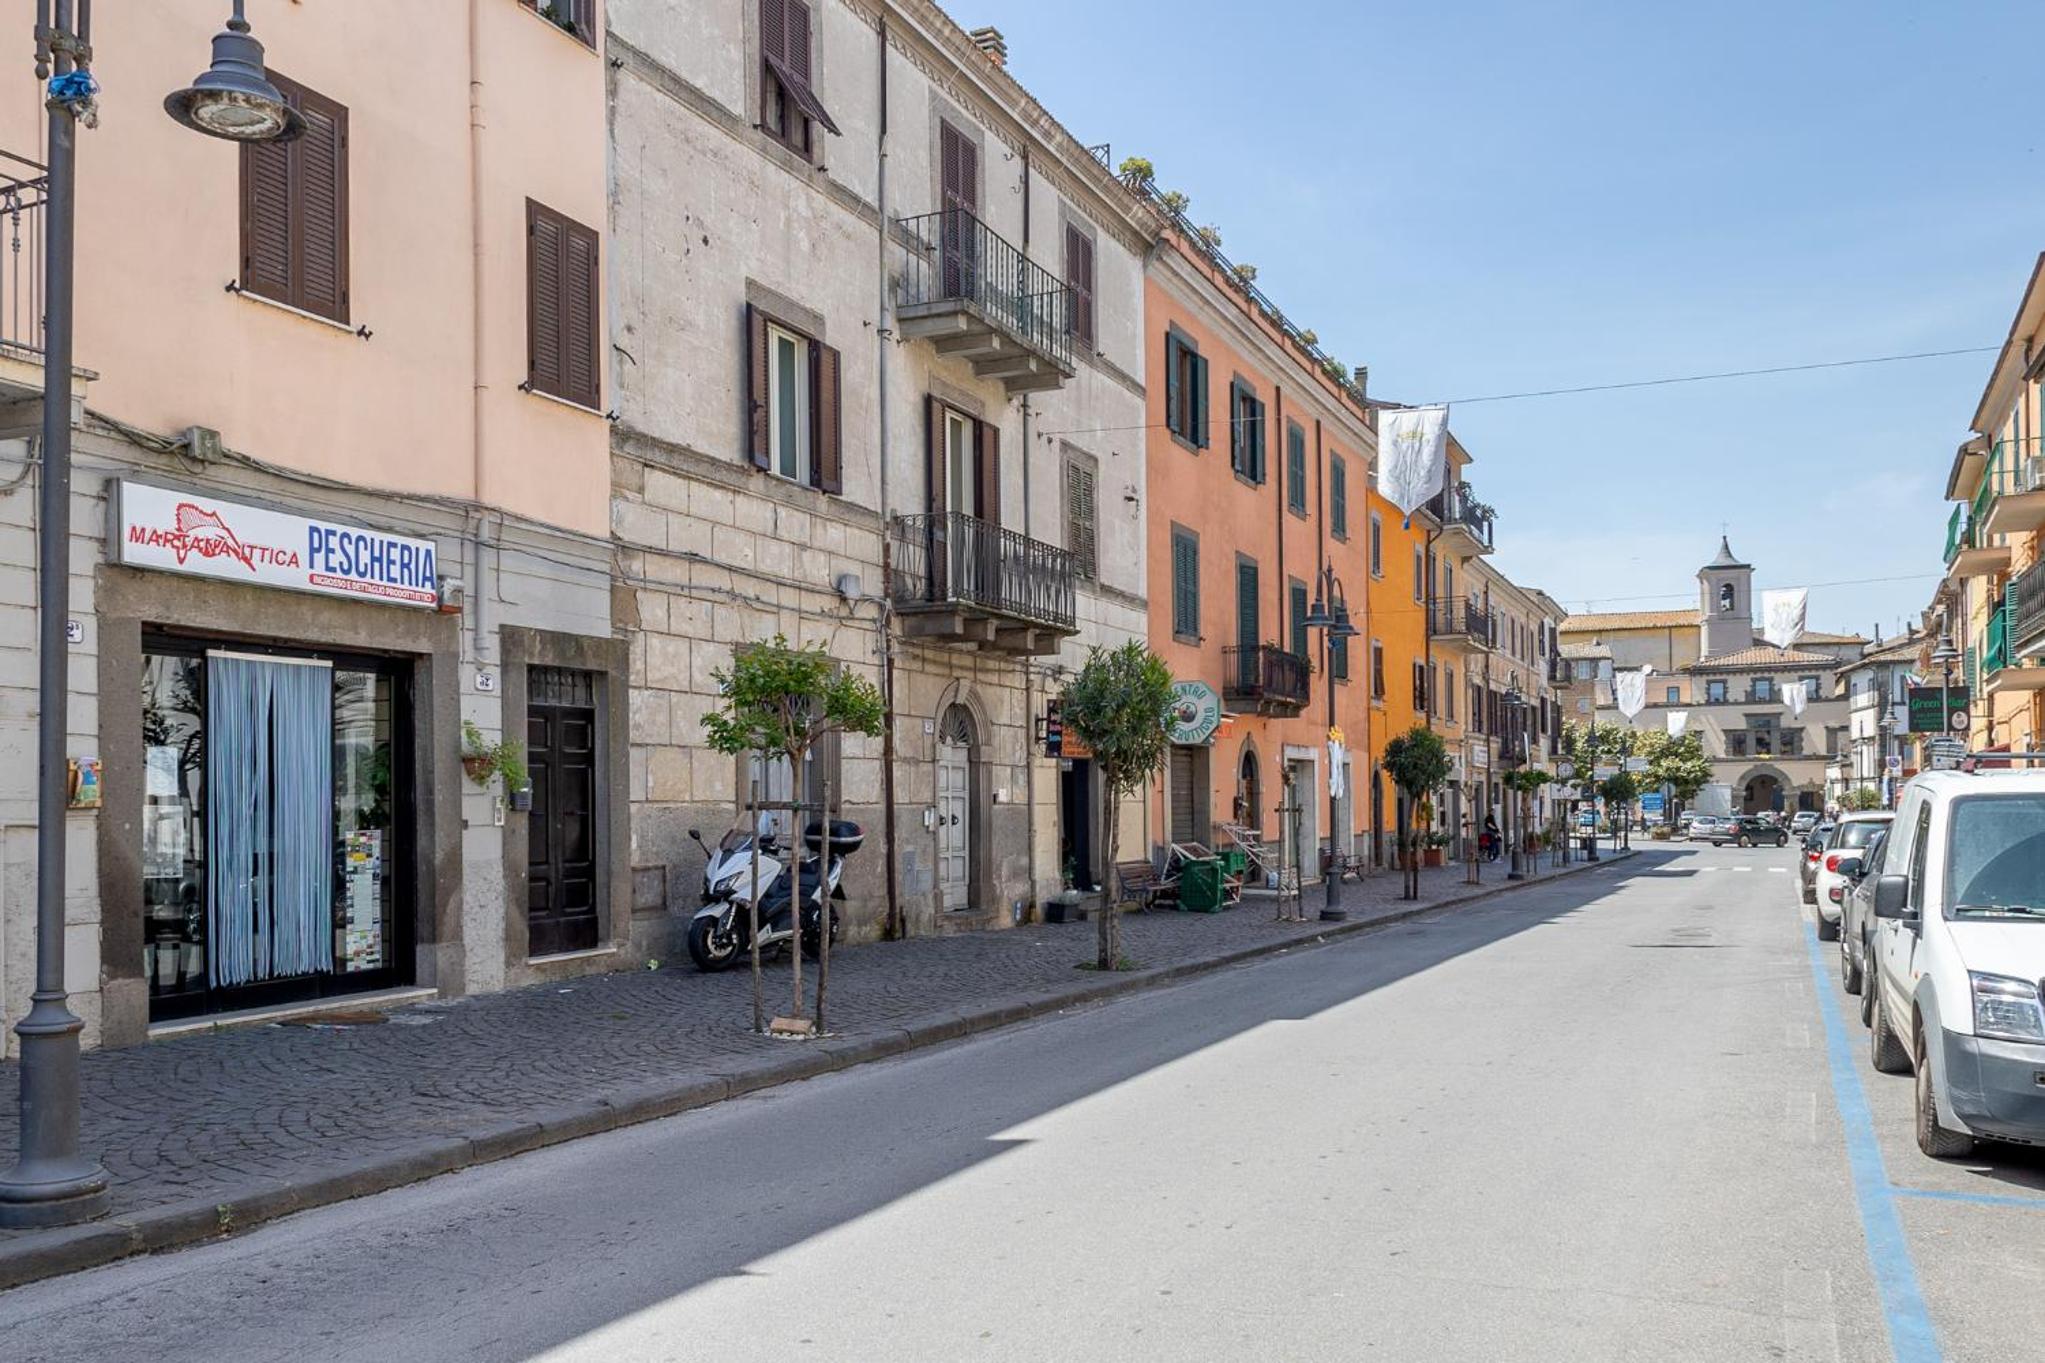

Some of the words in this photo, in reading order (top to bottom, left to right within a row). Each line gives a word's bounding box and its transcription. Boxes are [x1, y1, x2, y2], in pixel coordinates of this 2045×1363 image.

[308, 525, 436, 590] PESCHERIA
[352, 582, 385, 595] DETTAGLIO
[385, 586, 416, 600] PRODOTTI
